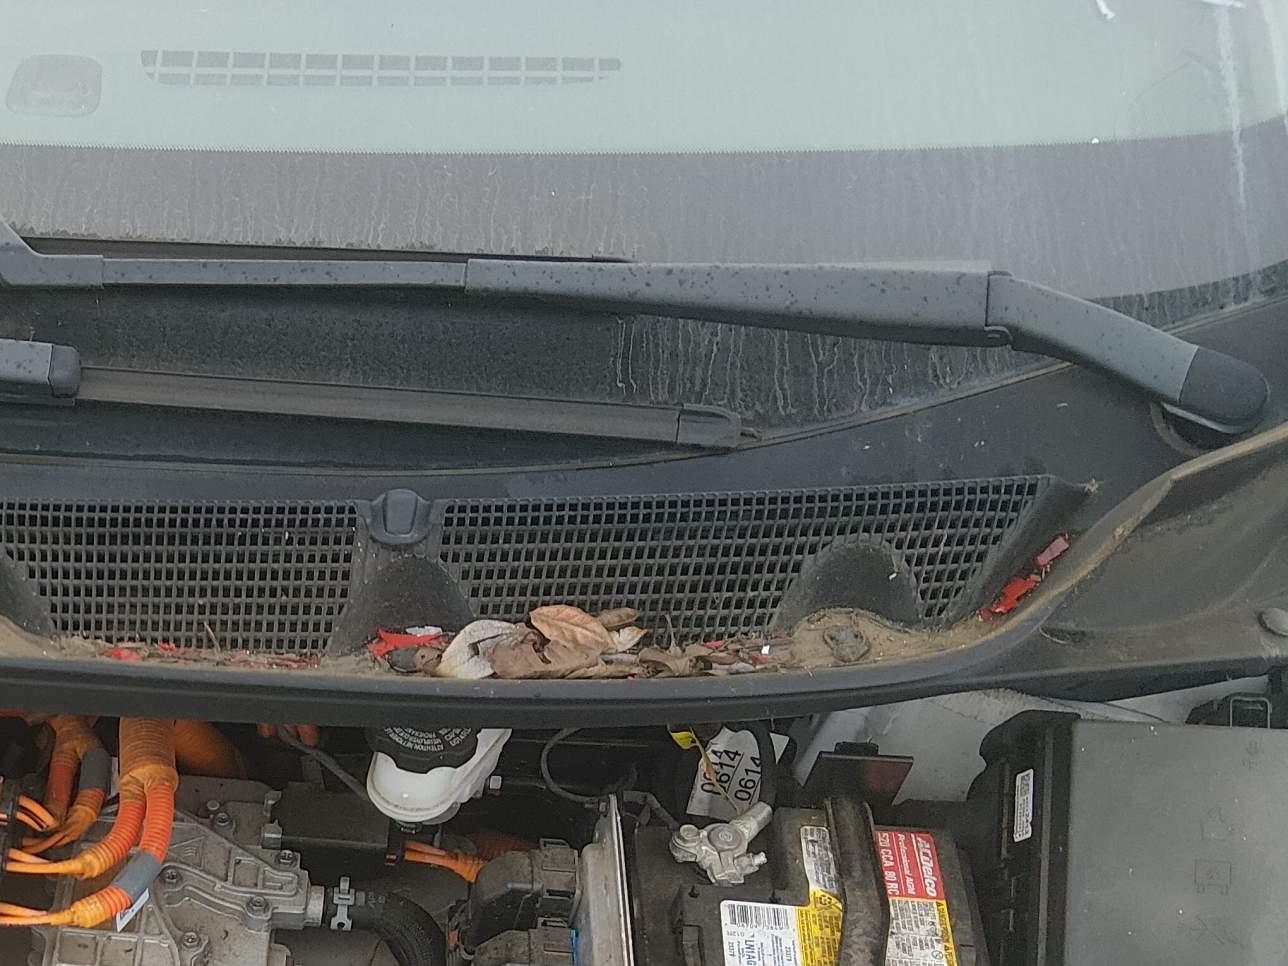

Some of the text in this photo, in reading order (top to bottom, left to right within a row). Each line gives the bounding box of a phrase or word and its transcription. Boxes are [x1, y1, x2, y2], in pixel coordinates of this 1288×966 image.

[880, 848, 893, 867] CCA
[887, 881, 899, 896] RC
[897, 833, 916, 895] Professional AGM
[916, 836, 937, 898] ACDelco
